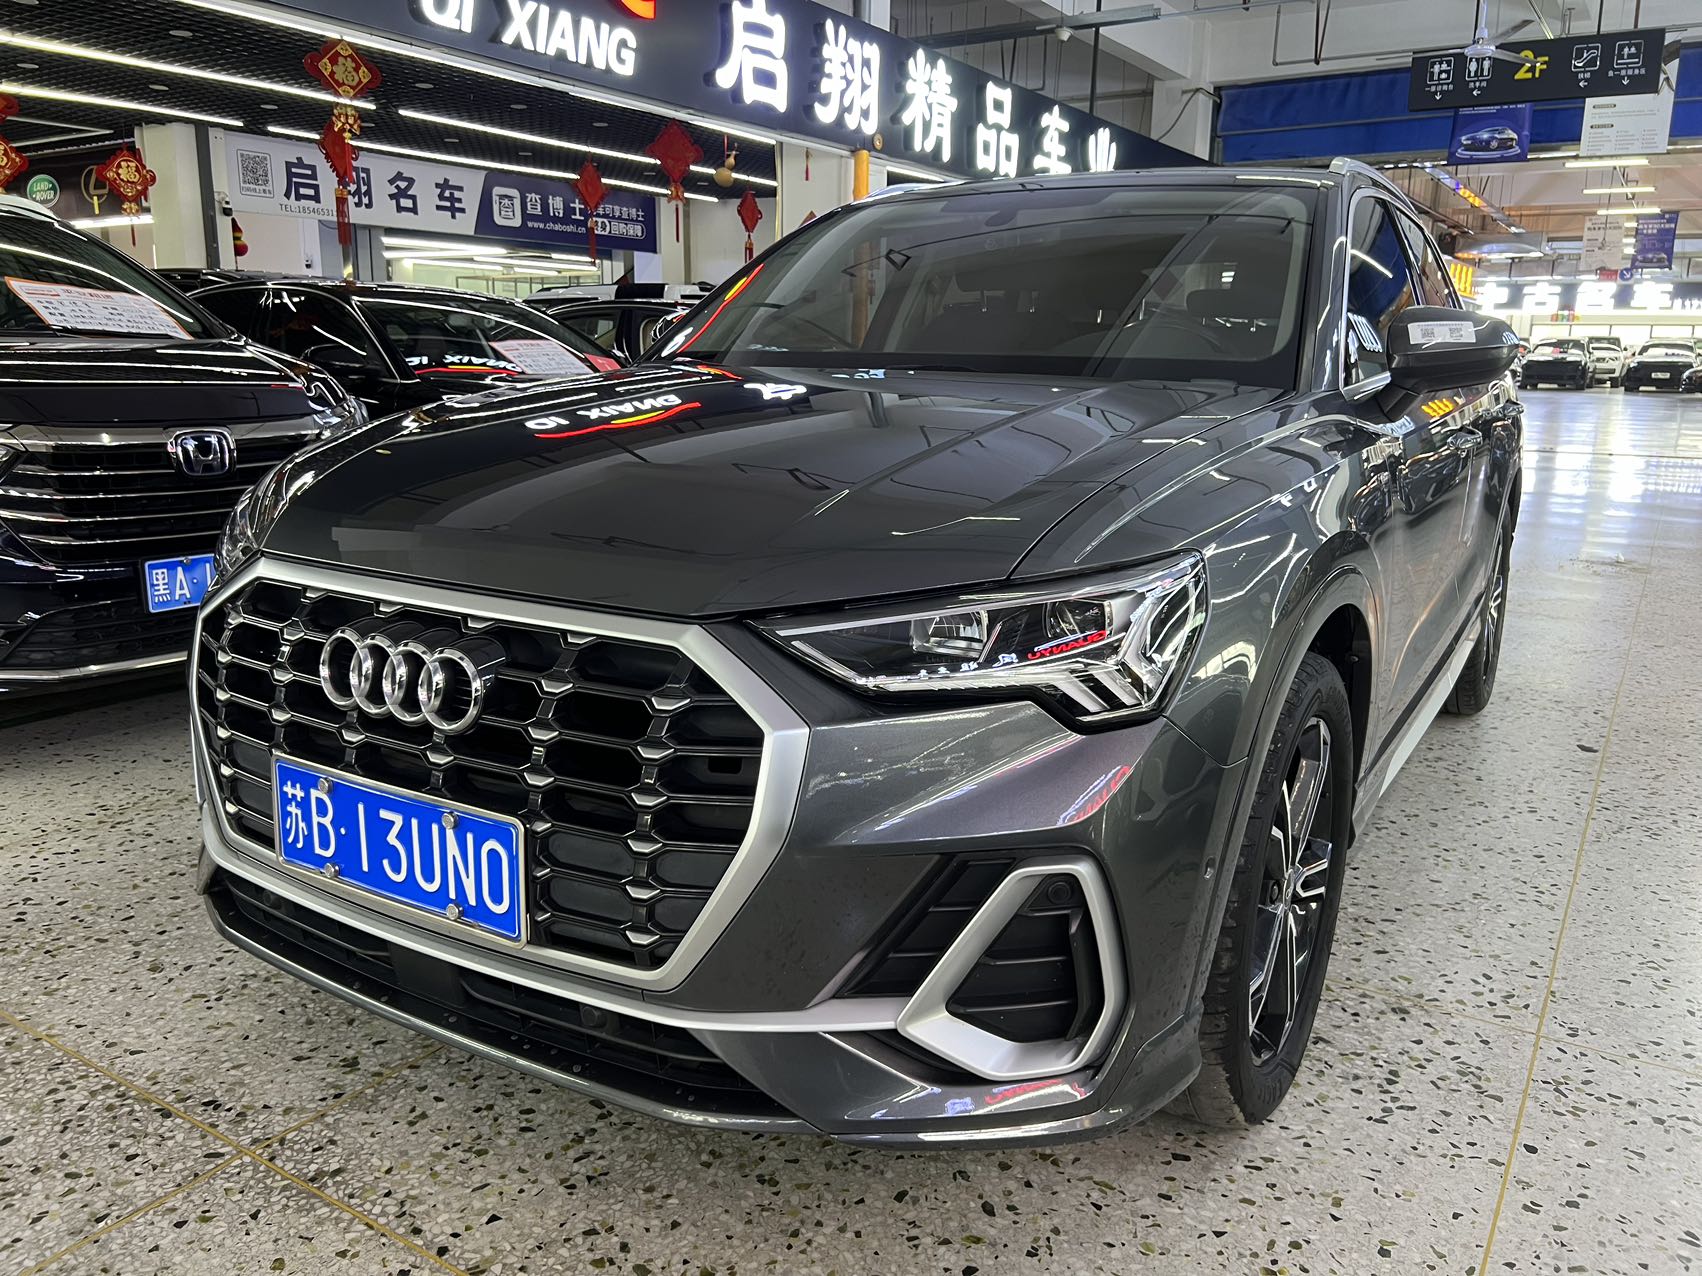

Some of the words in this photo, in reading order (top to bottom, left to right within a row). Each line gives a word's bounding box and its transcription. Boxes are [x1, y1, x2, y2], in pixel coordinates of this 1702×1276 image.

[422, 0, 474, 33] QI
[501, 0, 637, 76] XIANG
[1514, 50, 1549, 80] 2F
[716, 0, 1118, 178] 启翔精品车业
[33, 182, 49, 190] LAND
[36, 190, 55, 200] ROVER
[279, 203, 337, 217] TEL:18546531
[525, 193, 585, 220] 查博士
[588, 204, 645, 221] 车可享查博士
[527, 220, 586, 234] www.chaboshi.cn
